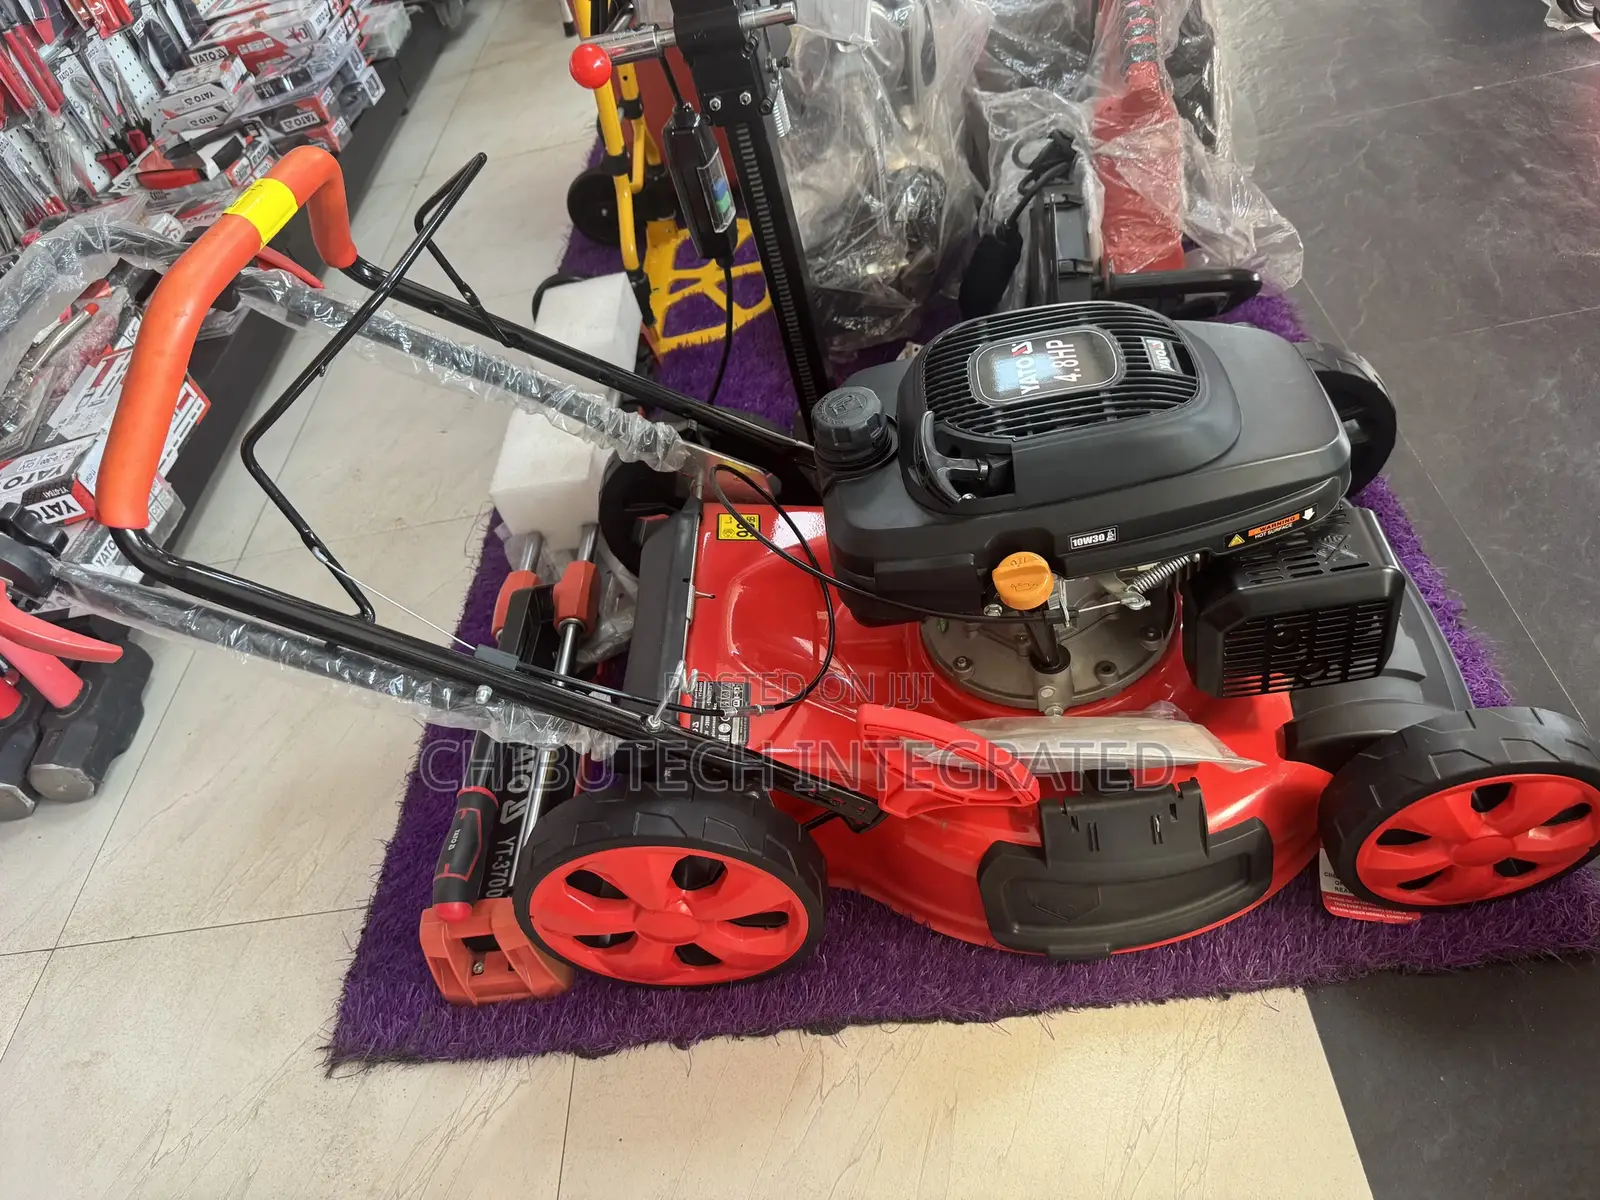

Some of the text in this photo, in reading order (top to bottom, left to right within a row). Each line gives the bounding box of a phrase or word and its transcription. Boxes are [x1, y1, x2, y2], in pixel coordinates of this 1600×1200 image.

[193, 51, 216, 64] YATO
[194, 90, 216, 103] YATO
[199, 114, 219, 125] YATO
[295, 112, 318, 126] YATO
[1046, 340, 1082, 383] 4.8HP
[1156, 349, 1177, 372] YATO
[1016, 357, 1040, 395] YATO
[2, 464, 64, 490] YATO
[1259, 516, 1296, 532] WARNING
[1072, 533, 1105, 547] 10W30
[507, 745, 536, 794] ATO
[486, 835, 517, 898] YT-3700
